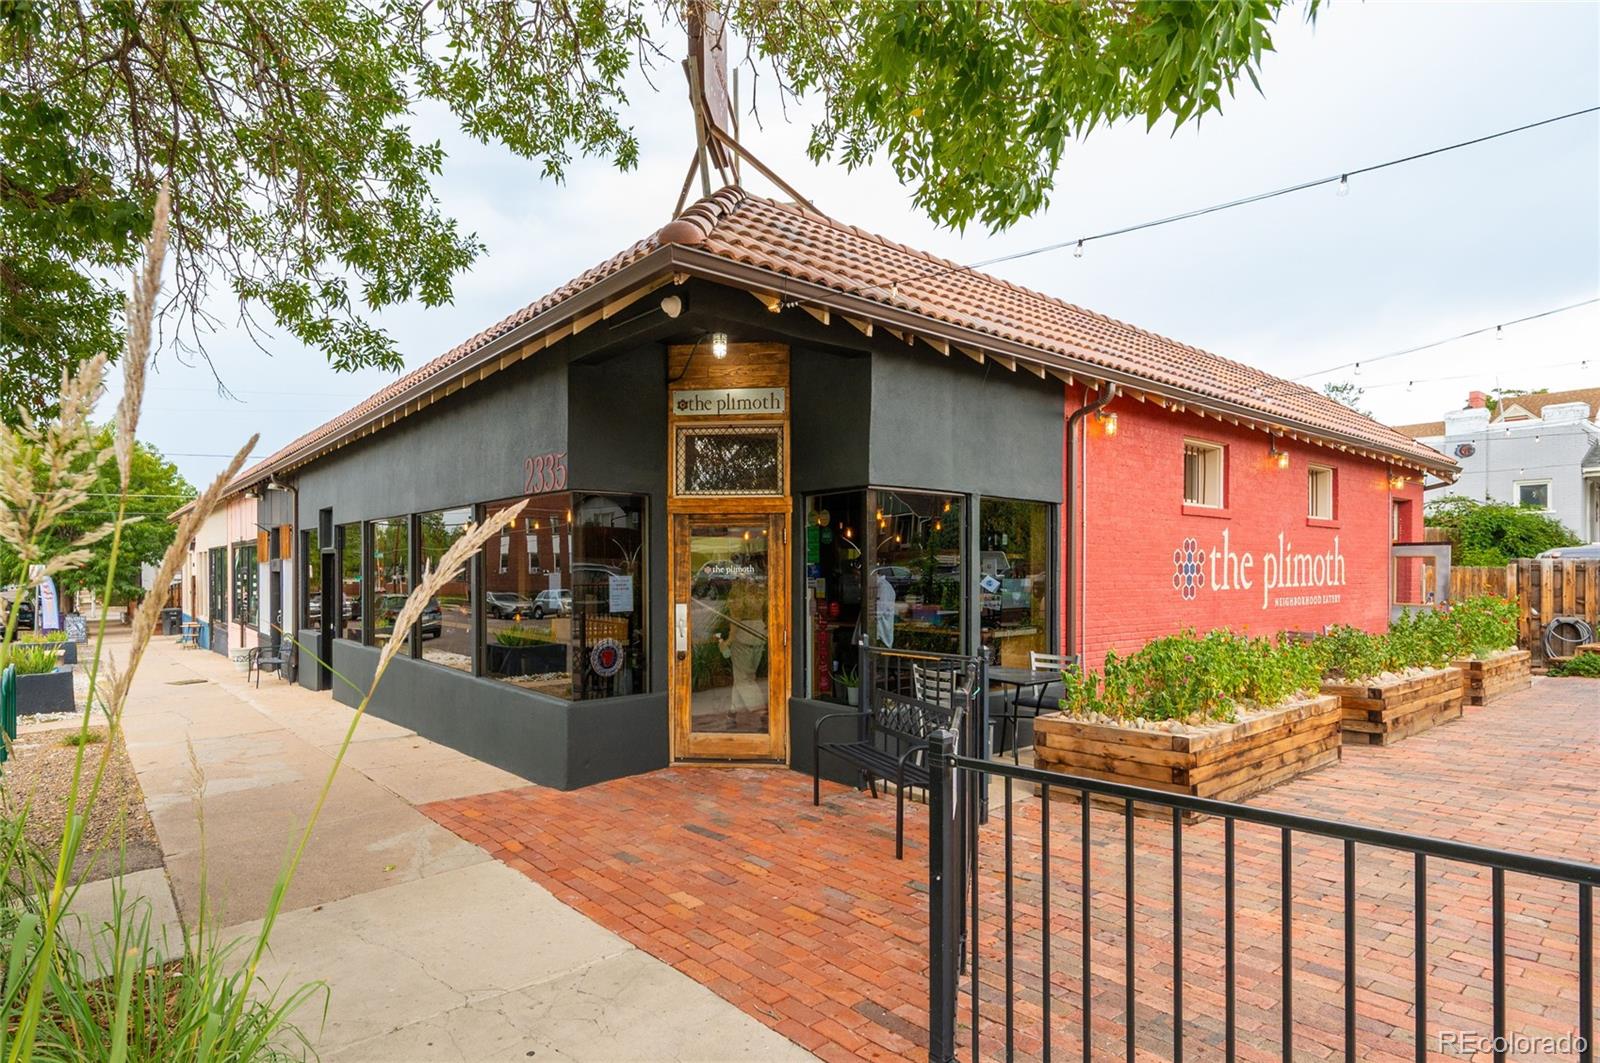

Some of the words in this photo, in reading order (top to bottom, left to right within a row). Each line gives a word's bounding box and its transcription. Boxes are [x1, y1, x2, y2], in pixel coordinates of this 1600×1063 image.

[688, 394, 712, 411] the
[716, 392, 780, 414] plimoth
[524, 452, 568, 494] 2335
[712, 564, 725, 573] the
[726, 564, 755, 575] plimoth
[1210, 528, 1254, 591] the
[1262, 531, 1346, 610] plimoth
[1275, 595, 1322, 607] NEIGHBORHOOD
[1322, 594, 1341, 604] EATERY
